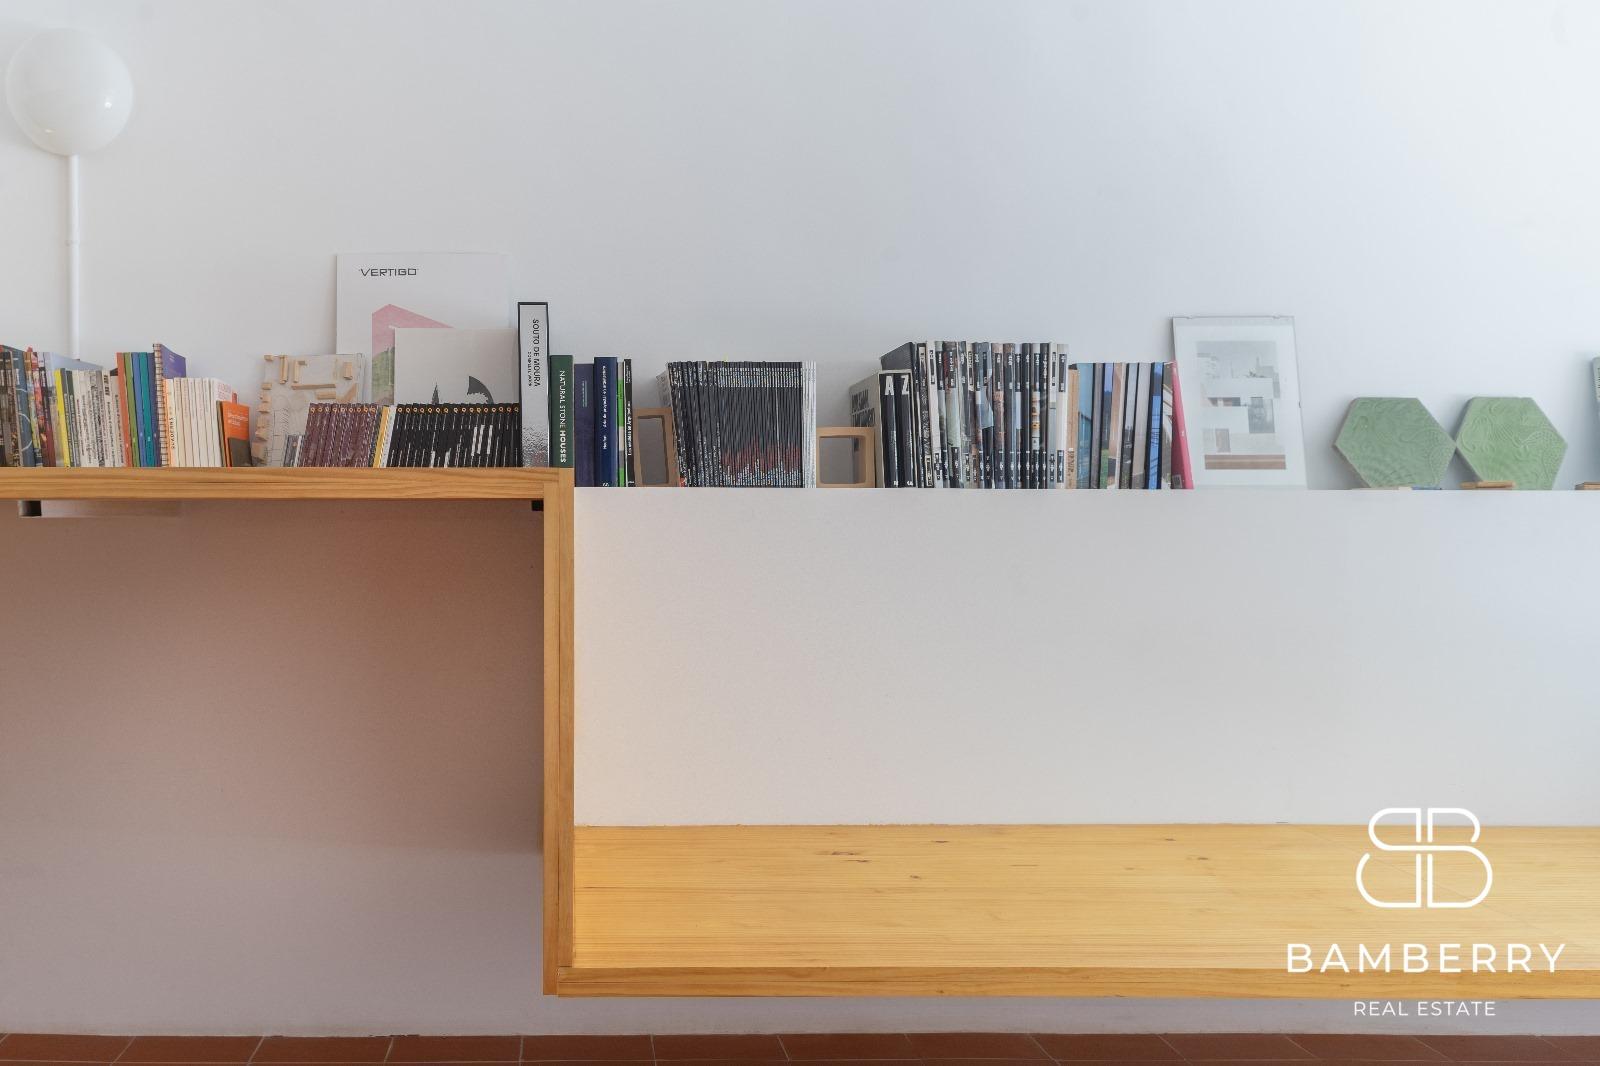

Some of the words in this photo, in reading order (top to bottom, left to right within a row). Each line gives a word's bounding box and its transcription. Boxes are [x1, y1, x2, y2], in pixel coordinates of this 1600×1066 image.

[360, 268, 417, 277] VERTIGO
[532, 318, 540, 345] SOUTO
[533, 346, 540, 357] DE
[533, 358, 541, 387] MOURA
[884, 375, 895, 396] A
[559, 404, 567, 429] STONE
[559, 430, 567, 463] HOUSES
